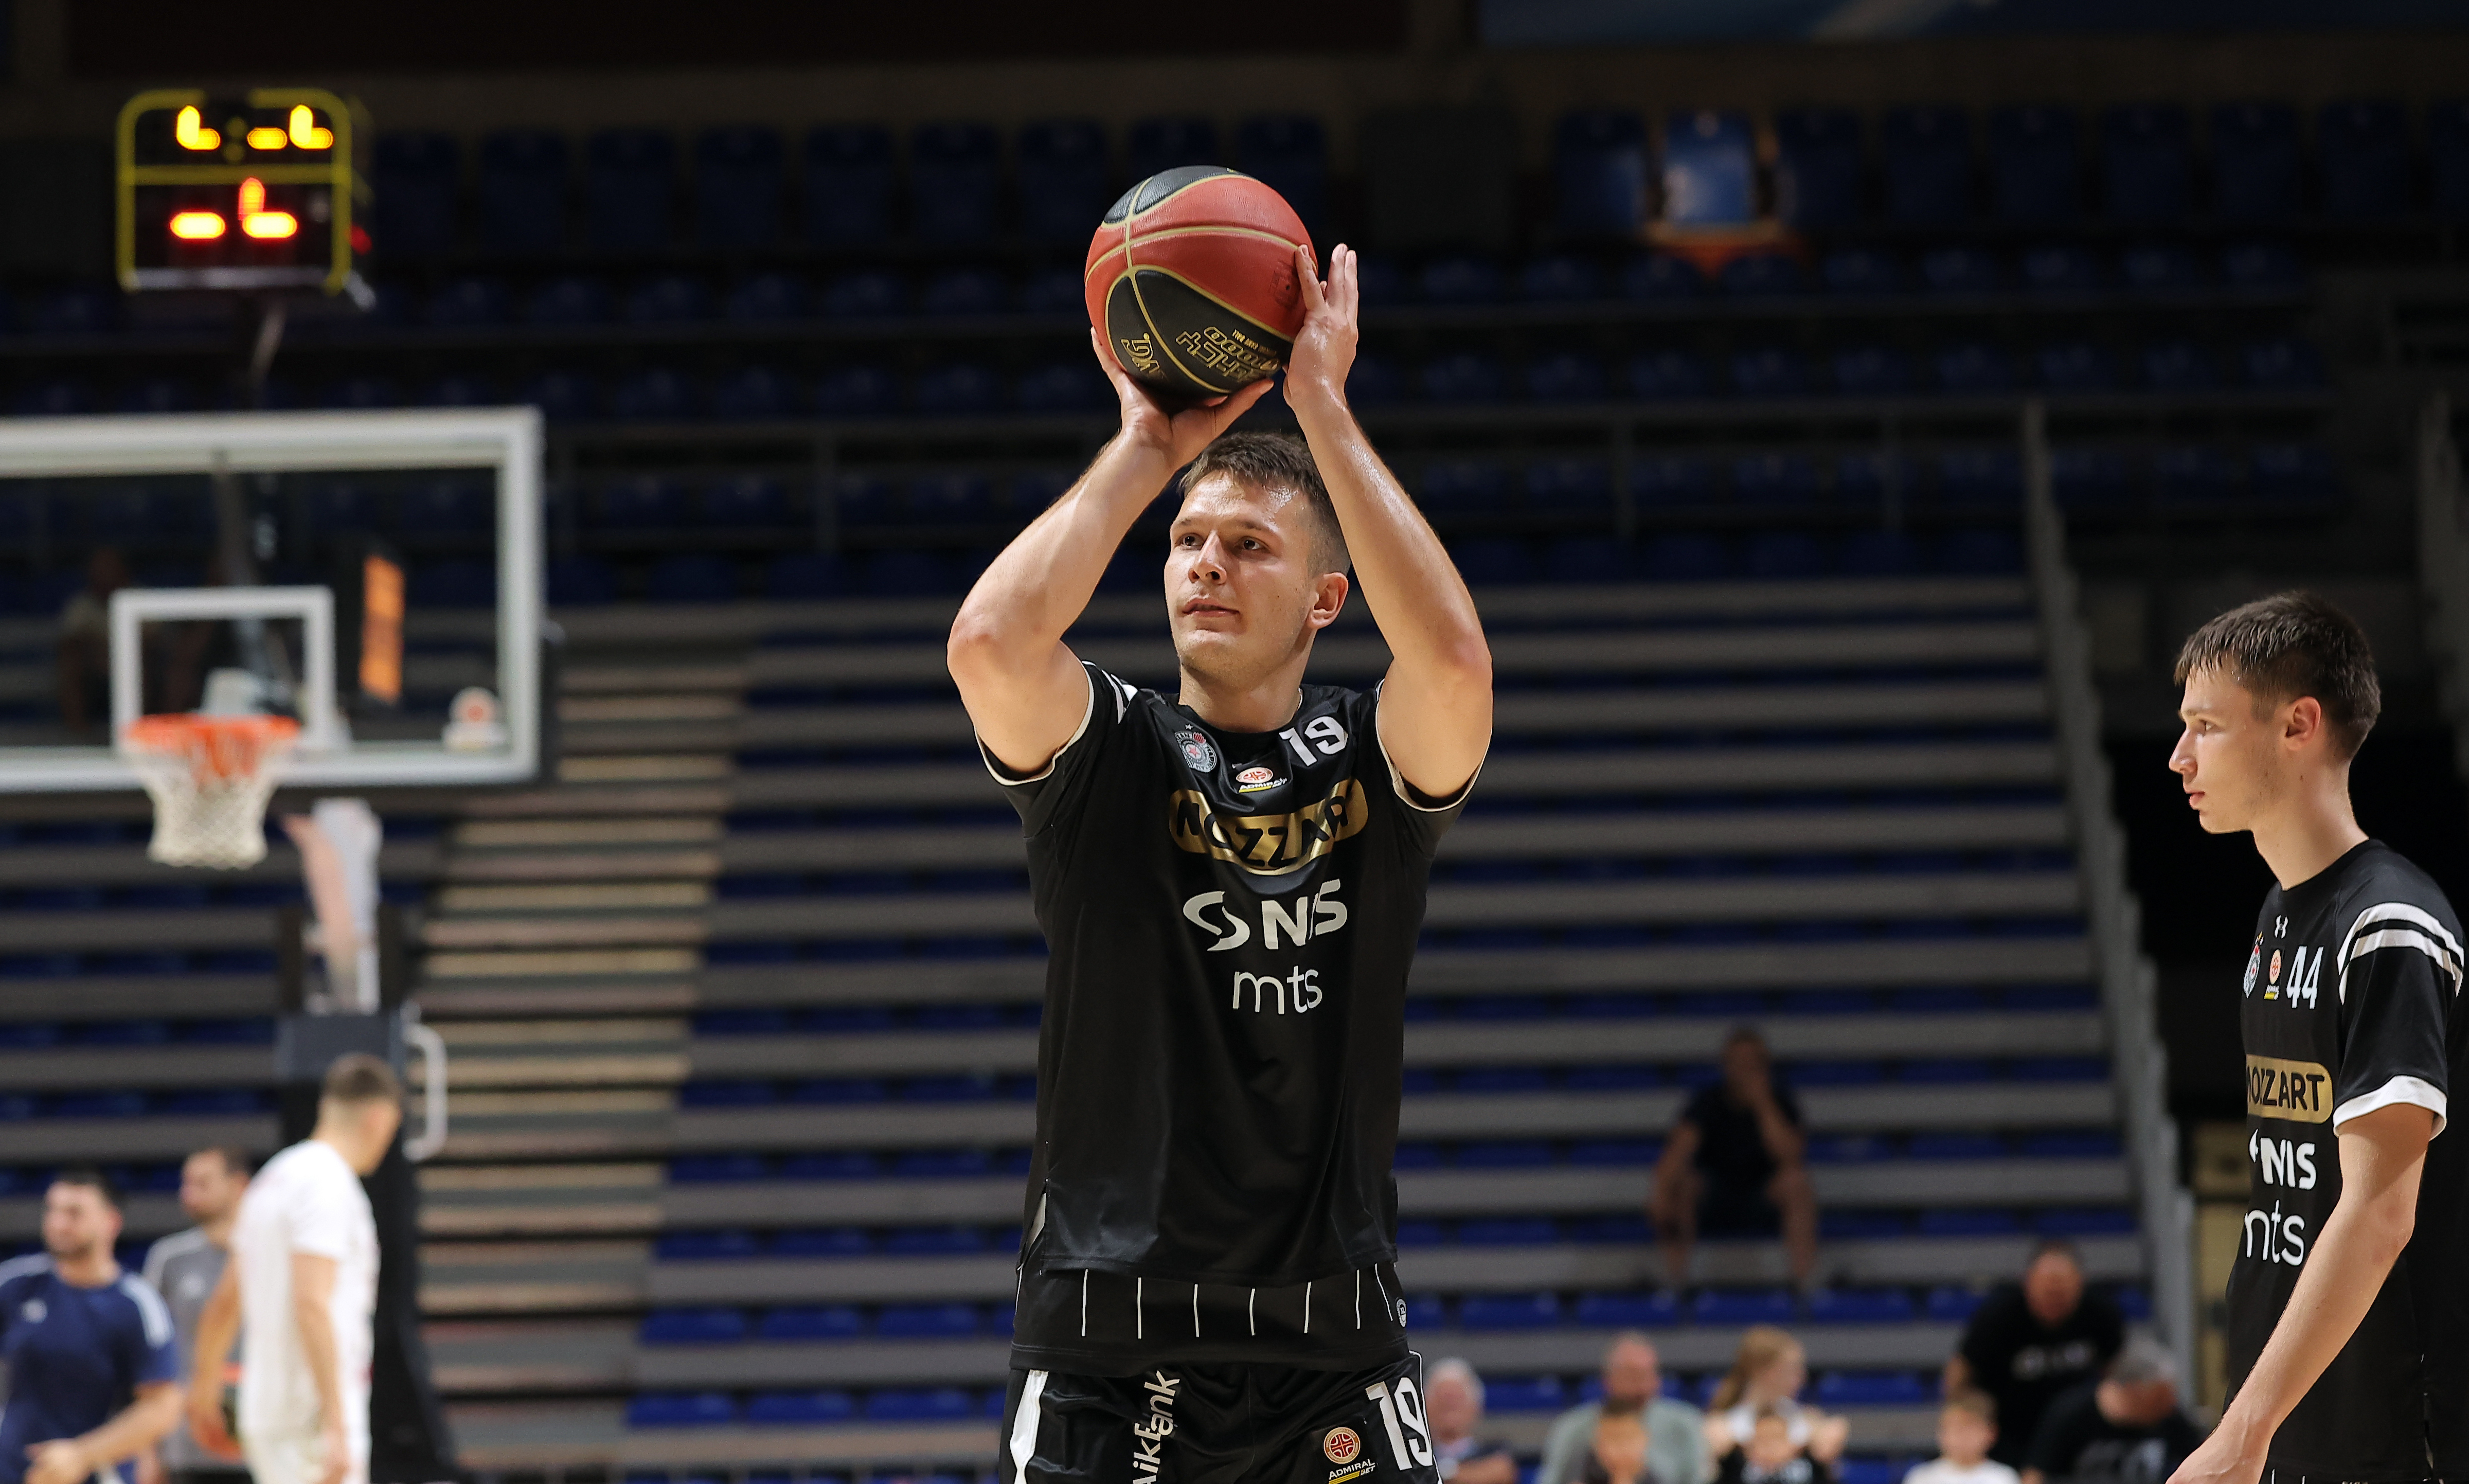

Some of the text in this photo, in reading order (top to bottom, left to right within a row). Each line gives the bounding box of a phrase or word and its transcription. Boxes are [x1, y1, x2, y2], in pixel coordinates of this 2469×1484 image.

[1279, 715, 1348, 767] 19
[1176, 795, 1350, 868] MOZZAR
[1261, 878, 1348, 950] NIS
[1232, 965, 1322, 1015] mts
[2286, 945, 2324, 1009] 44
[2260, 1137, 2317, 1190] NIS
[1365, 1377, 1434, 1471] 19
[1329, 1458, 1375, 1480] ADMIRAL
[1360, 1465, 1376, 1476] BET
